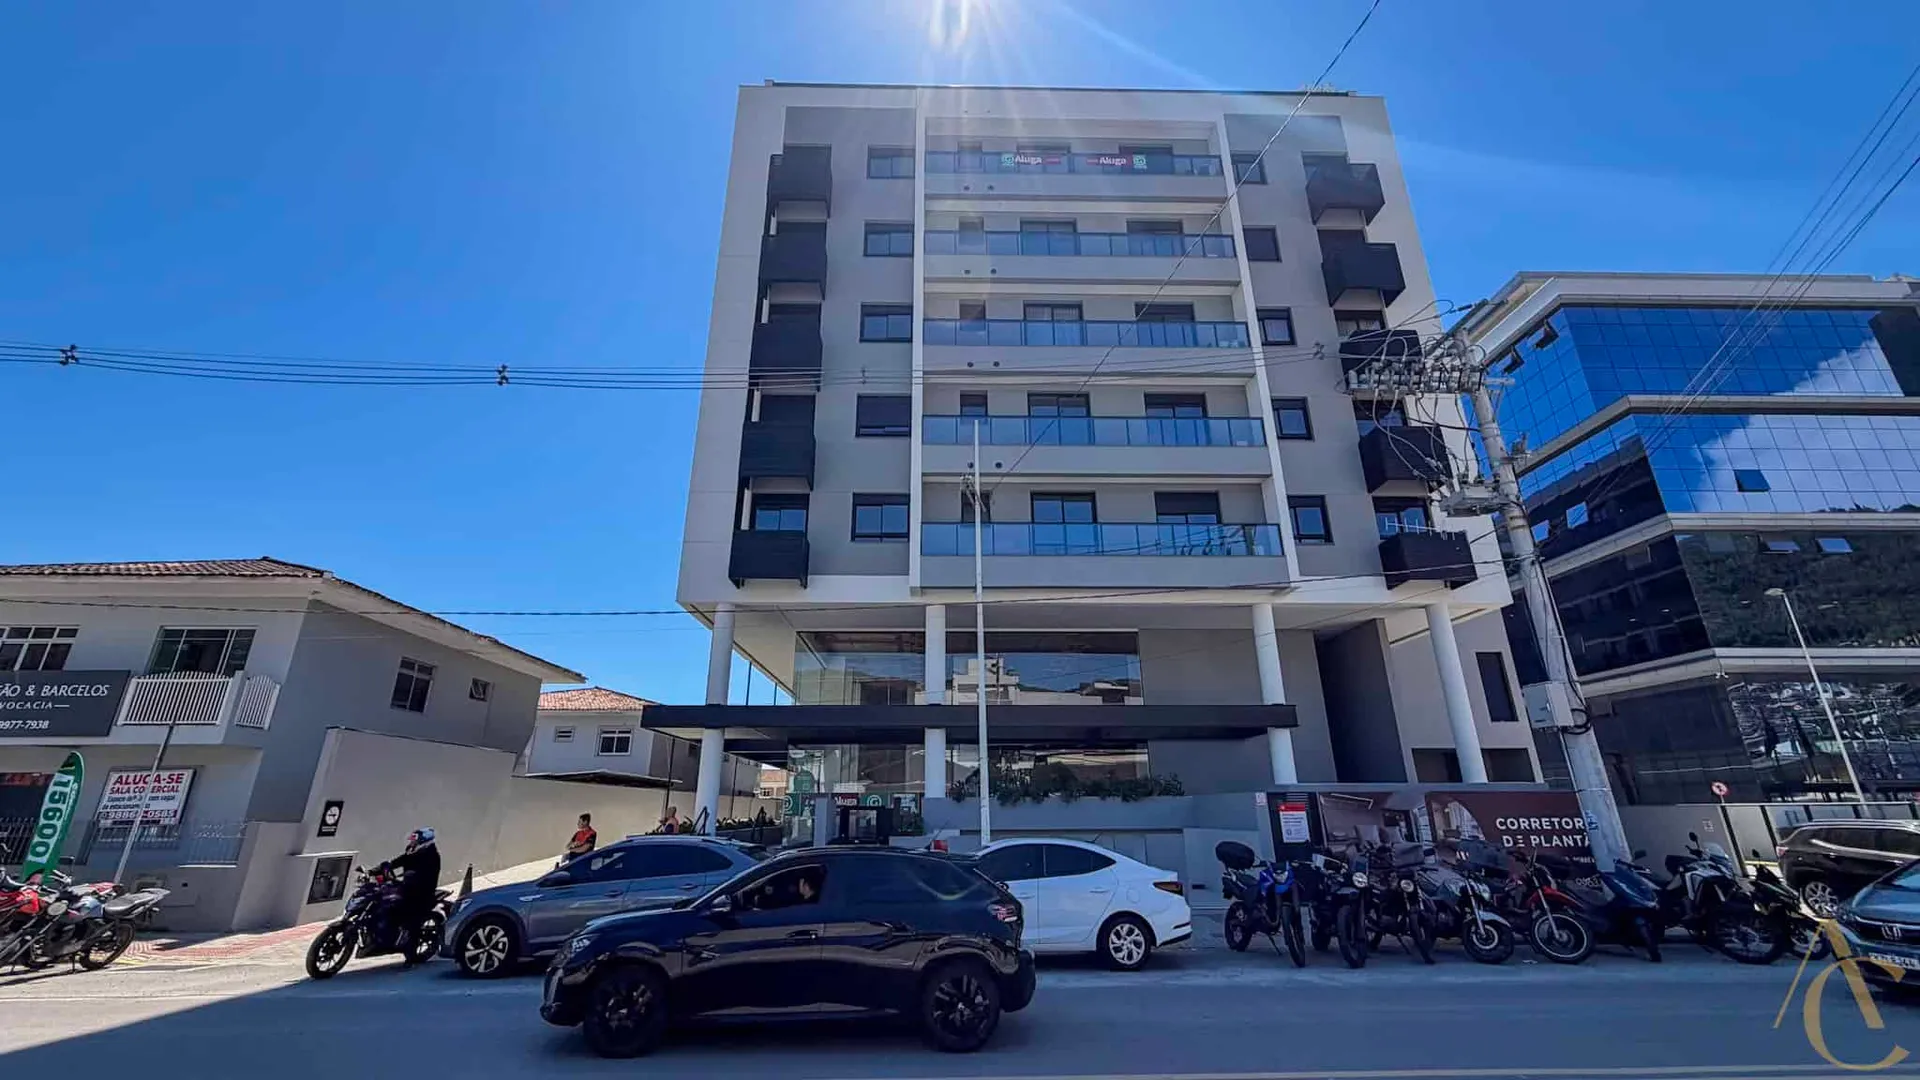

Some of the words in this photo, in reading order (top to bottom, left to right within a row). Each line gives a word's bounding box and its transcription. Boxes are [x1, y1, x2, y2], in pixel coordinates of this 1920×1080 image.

[1015, 154, 1042, 165] Aluga
[1099, 156, 1127, 166] Aluga
[0, 683, 21, 697] ÃO
[25, 684, 36, 696] &
[41, 684, 110, 697] BARCELOS
[109, 786, 131, 795] SALA
[133, 785, 180, 795] COERCIAL
[30, 779, 72, 858] 15600
[1495, 817, 1585, 830] CORRETOR
[1502, 835, 1525, 847] DE
